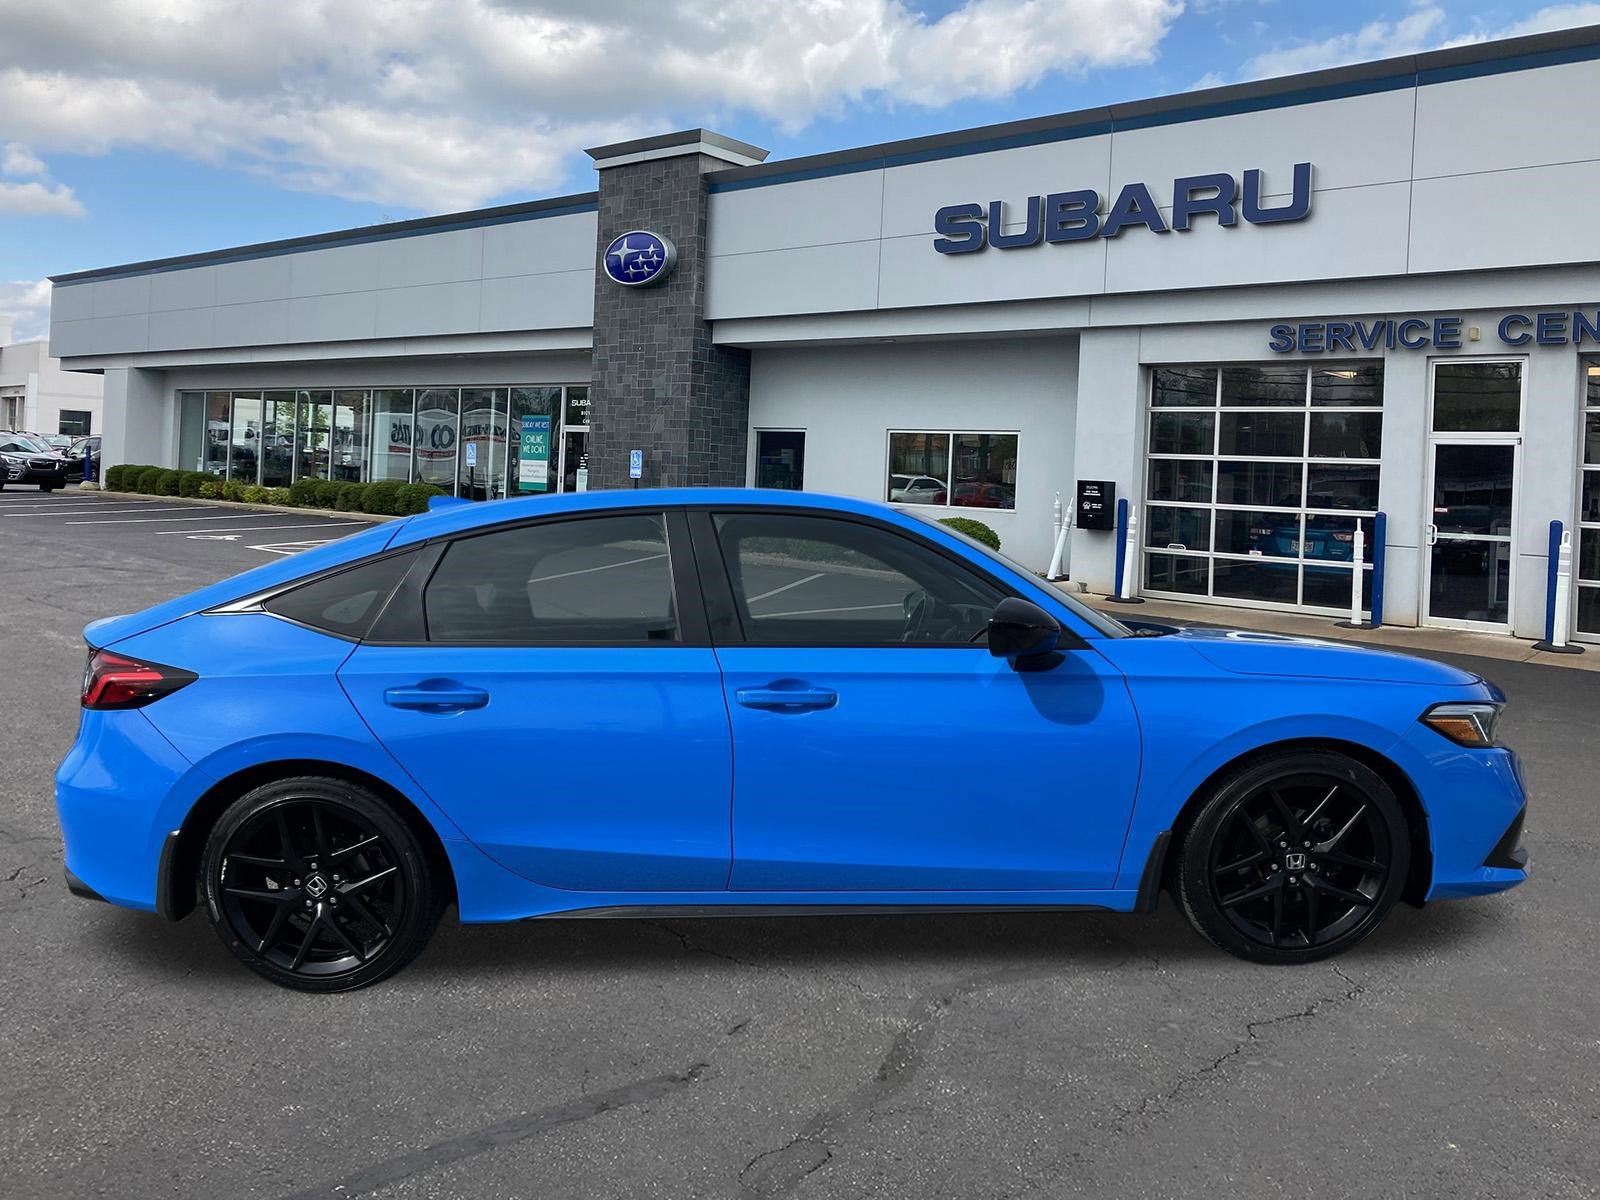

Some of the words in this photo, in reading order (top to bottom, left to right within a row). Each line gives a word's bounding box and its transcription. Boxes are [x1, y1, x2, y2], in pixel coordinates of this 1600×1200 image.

[933, 161, 1314, 255] SUBARU
[1268, 317, 1463, 352] SERVICE
[1497, 311, 1600, 346] CEN
